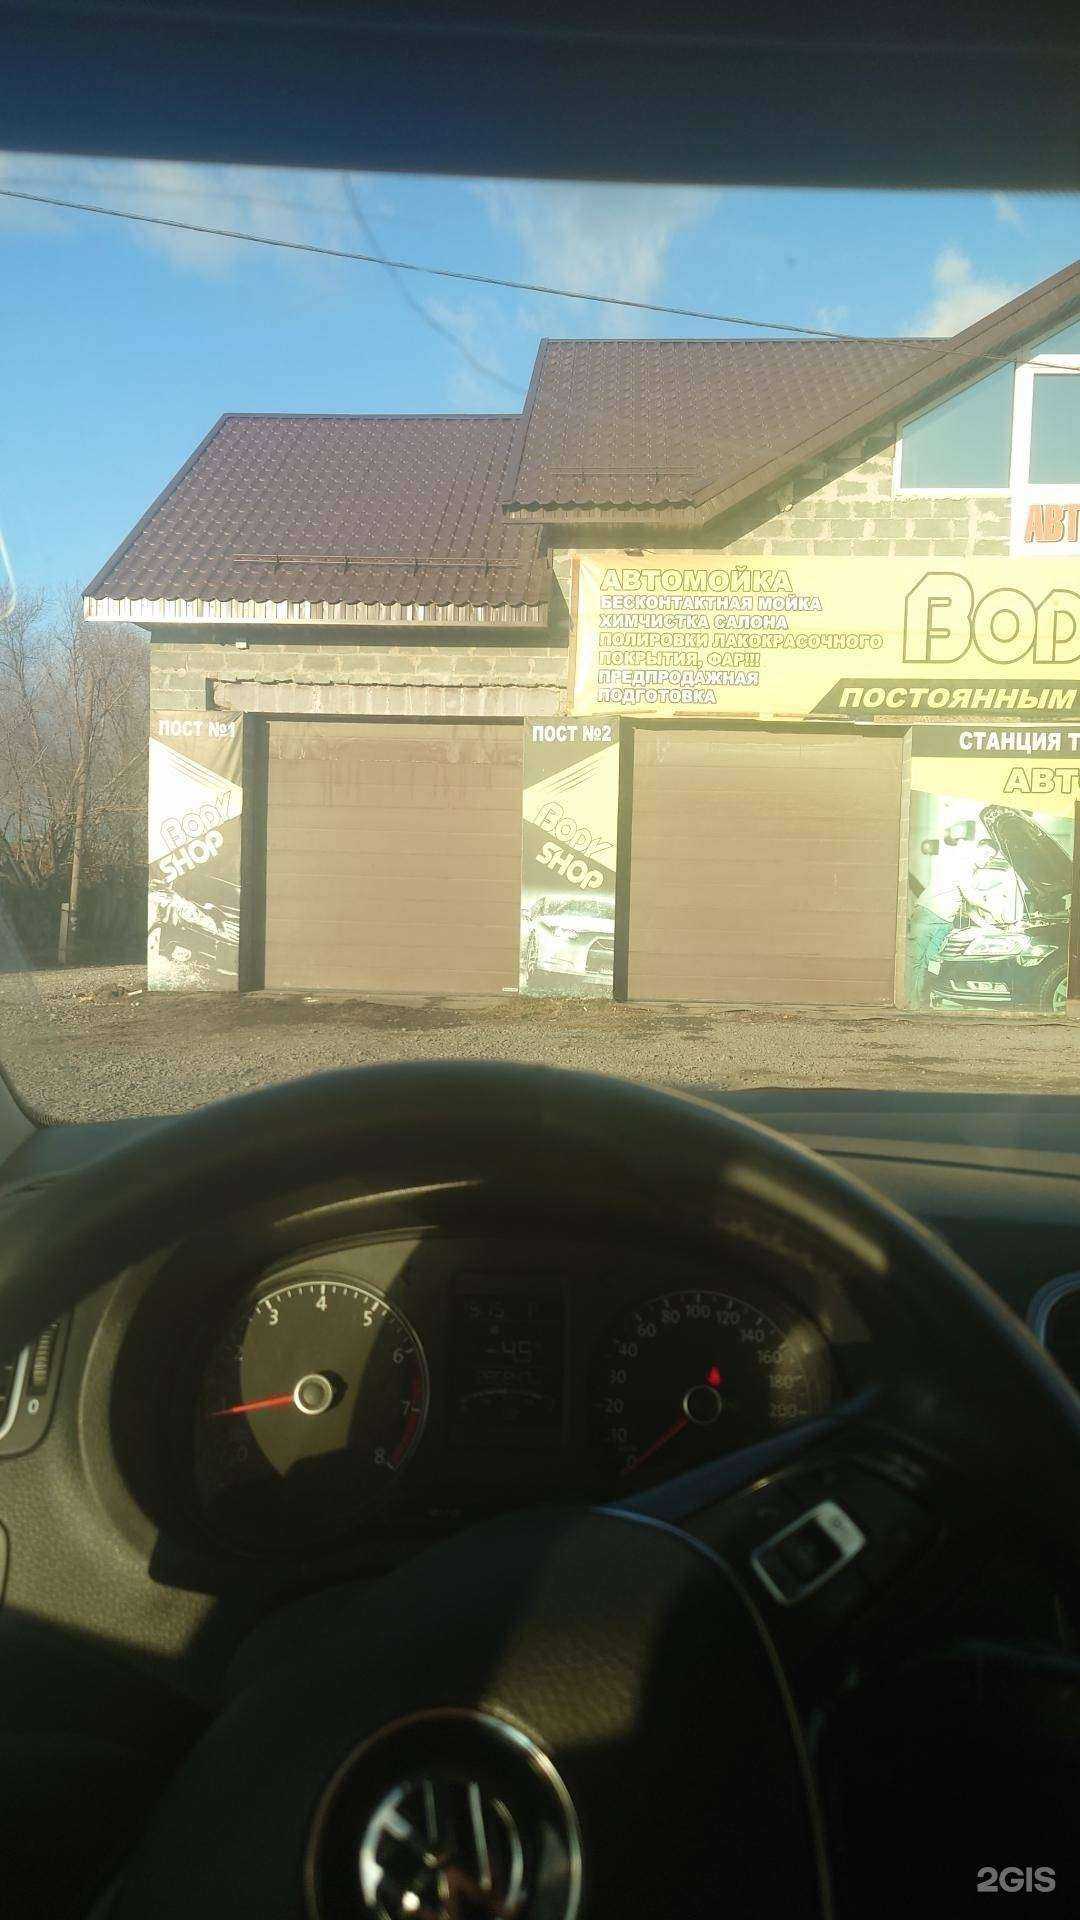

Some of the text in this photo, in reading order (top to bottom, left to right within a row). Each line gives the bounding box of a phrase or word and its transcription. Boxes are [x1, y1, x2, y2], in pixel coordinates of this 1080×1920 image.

[600, 565, 793, 592] АВТОМОЙКА
[600, 594, 823, 611] БЕСКОНТАКТНАЯ МОЙКА
[599, 614, 789, 630] ХИМЧИСТКА САЛОНА
[599, 632, 884, 649] ПОЛИРОВКИ ЛАКОКРАСОЧНОГО
[599, 651, 761, 668] ПОКРЫТИЯ, ФАР!!!
[598, 669, 760, 687] ПРЕДПРОДАЖНАЯ
[597, 688, 717, 705] ПОДГОТОВКА
[839, 687, 1077, 710] ПОСТОЯННЫМ
[158, 719, 236, 738] ПОСТ №1
[532, 725, 612, 742] ПОСТ №2
[959, 731, 1062, 755] СТАНЦИЯ
[1003, 766, 1080, 794] АВТ
[160, 789, 232, 852] BODY
[534, 801, 616, 858] BODY
[158, 829, 225, 885] SHOP
[535, 841, 605, 890] SHOP
[316, 1296, 328, 1311] 4
[685, 1304, 712, 1319] 100
[268, 1308, 279, 1326] 3
[362, 1310, 374, 1327] 5
